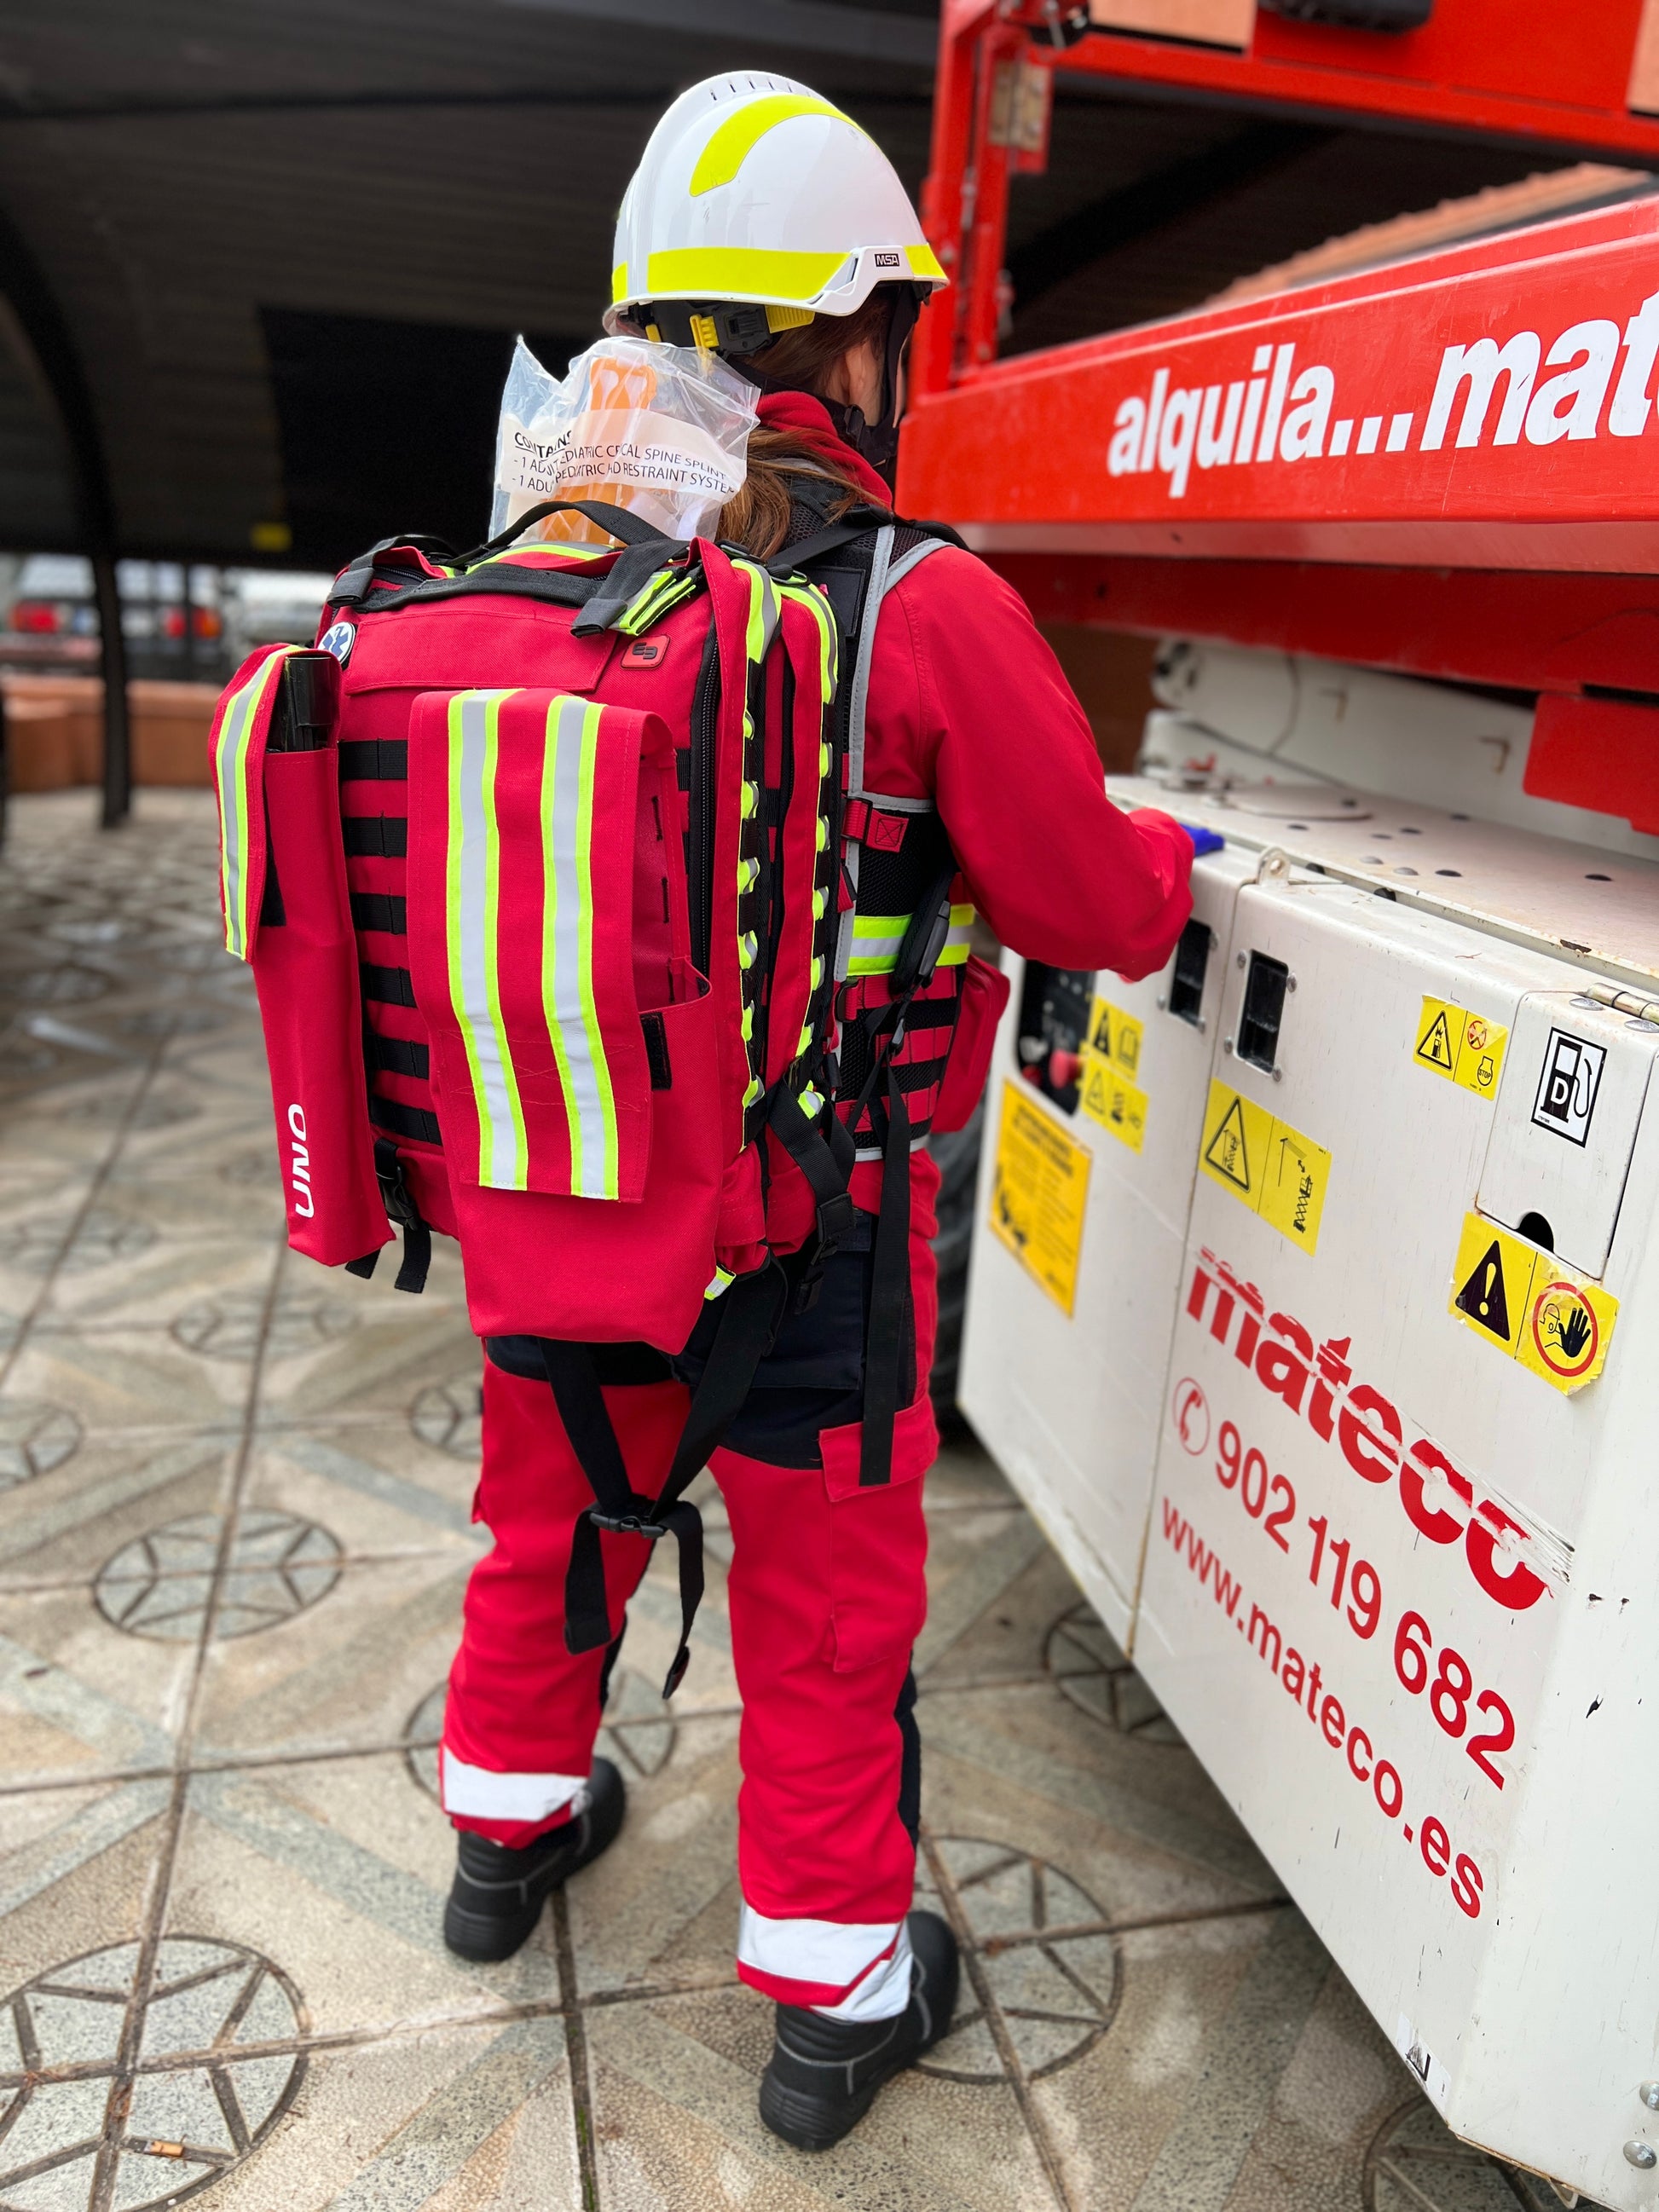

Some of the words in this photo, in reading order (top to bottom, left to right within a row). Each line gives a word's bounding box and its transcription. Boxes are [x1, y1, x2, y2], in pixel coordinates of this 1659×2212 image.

[876, 255, 899, 266] MSA
[623, 463, 688, 484] RESTRAINT
[644, 448, 681, 465] SPINE
[684, 458, 726, 480] SPLINT
[1478, 1068, 1492, 1079] STOP
[1550, 1076, 1569, 1105] D
[287, 1103, 315, 1218] UNO
[1186, 1245, 1553, 1610] mateco
[1215, 1420, 1297, 1554] 902
[1307, 1514, 1382, 1640] 119
[1393, 1610, 1516, 1791] 682
[1162, 1497, 1484, 1919] www.mateco.es
